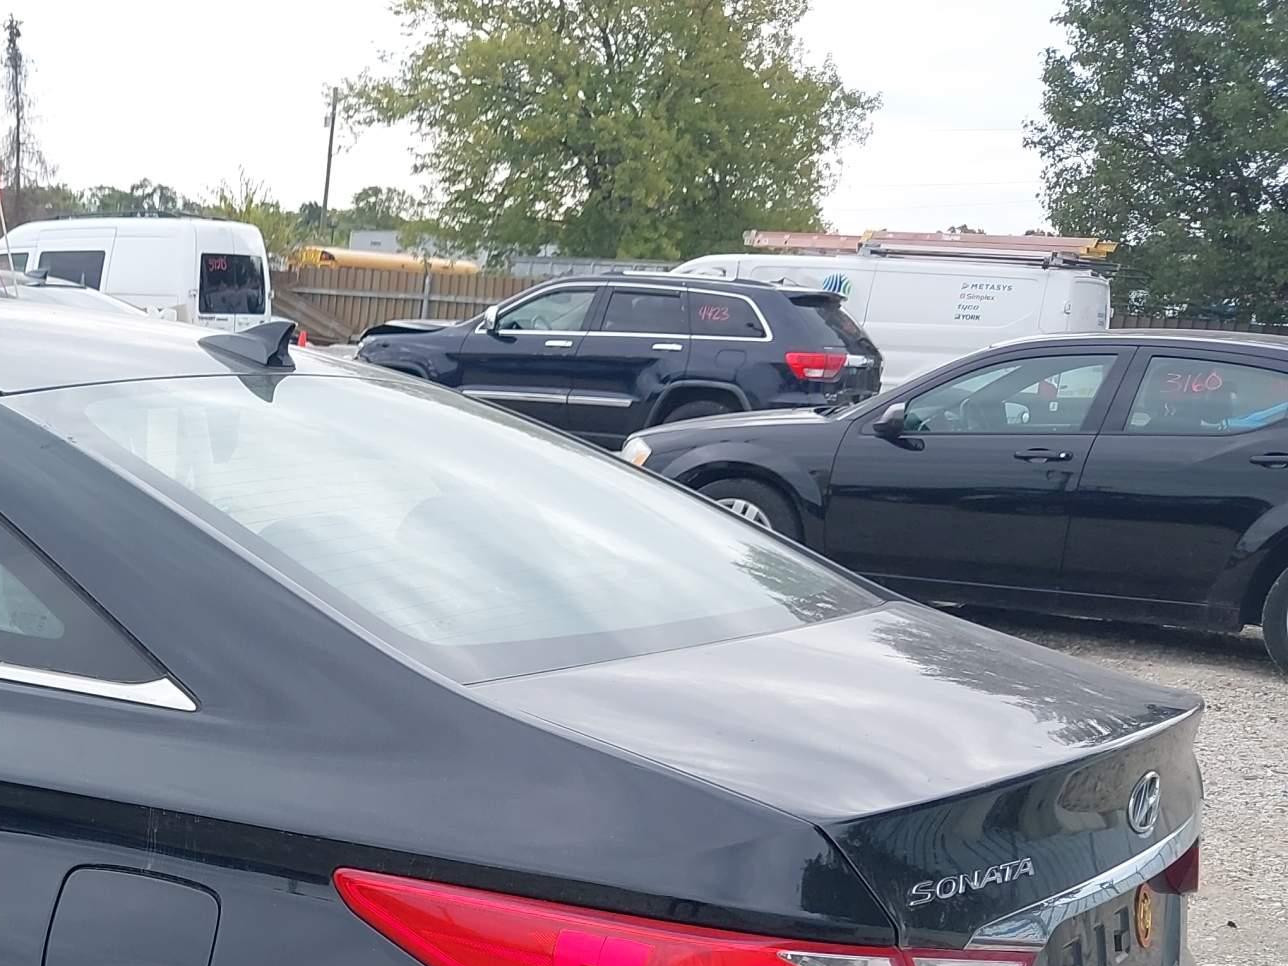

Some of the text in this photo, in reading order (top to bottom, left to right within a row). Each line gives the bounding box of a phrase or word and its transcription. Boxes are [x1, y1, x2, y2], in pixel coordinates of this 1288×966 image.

[970, 283, 1013, 291] METASYS
[698, 304, 730, 321] 4423
[1160, 369, 1223, 393] 3160
[908, 857, 1036, 907] SONATA
